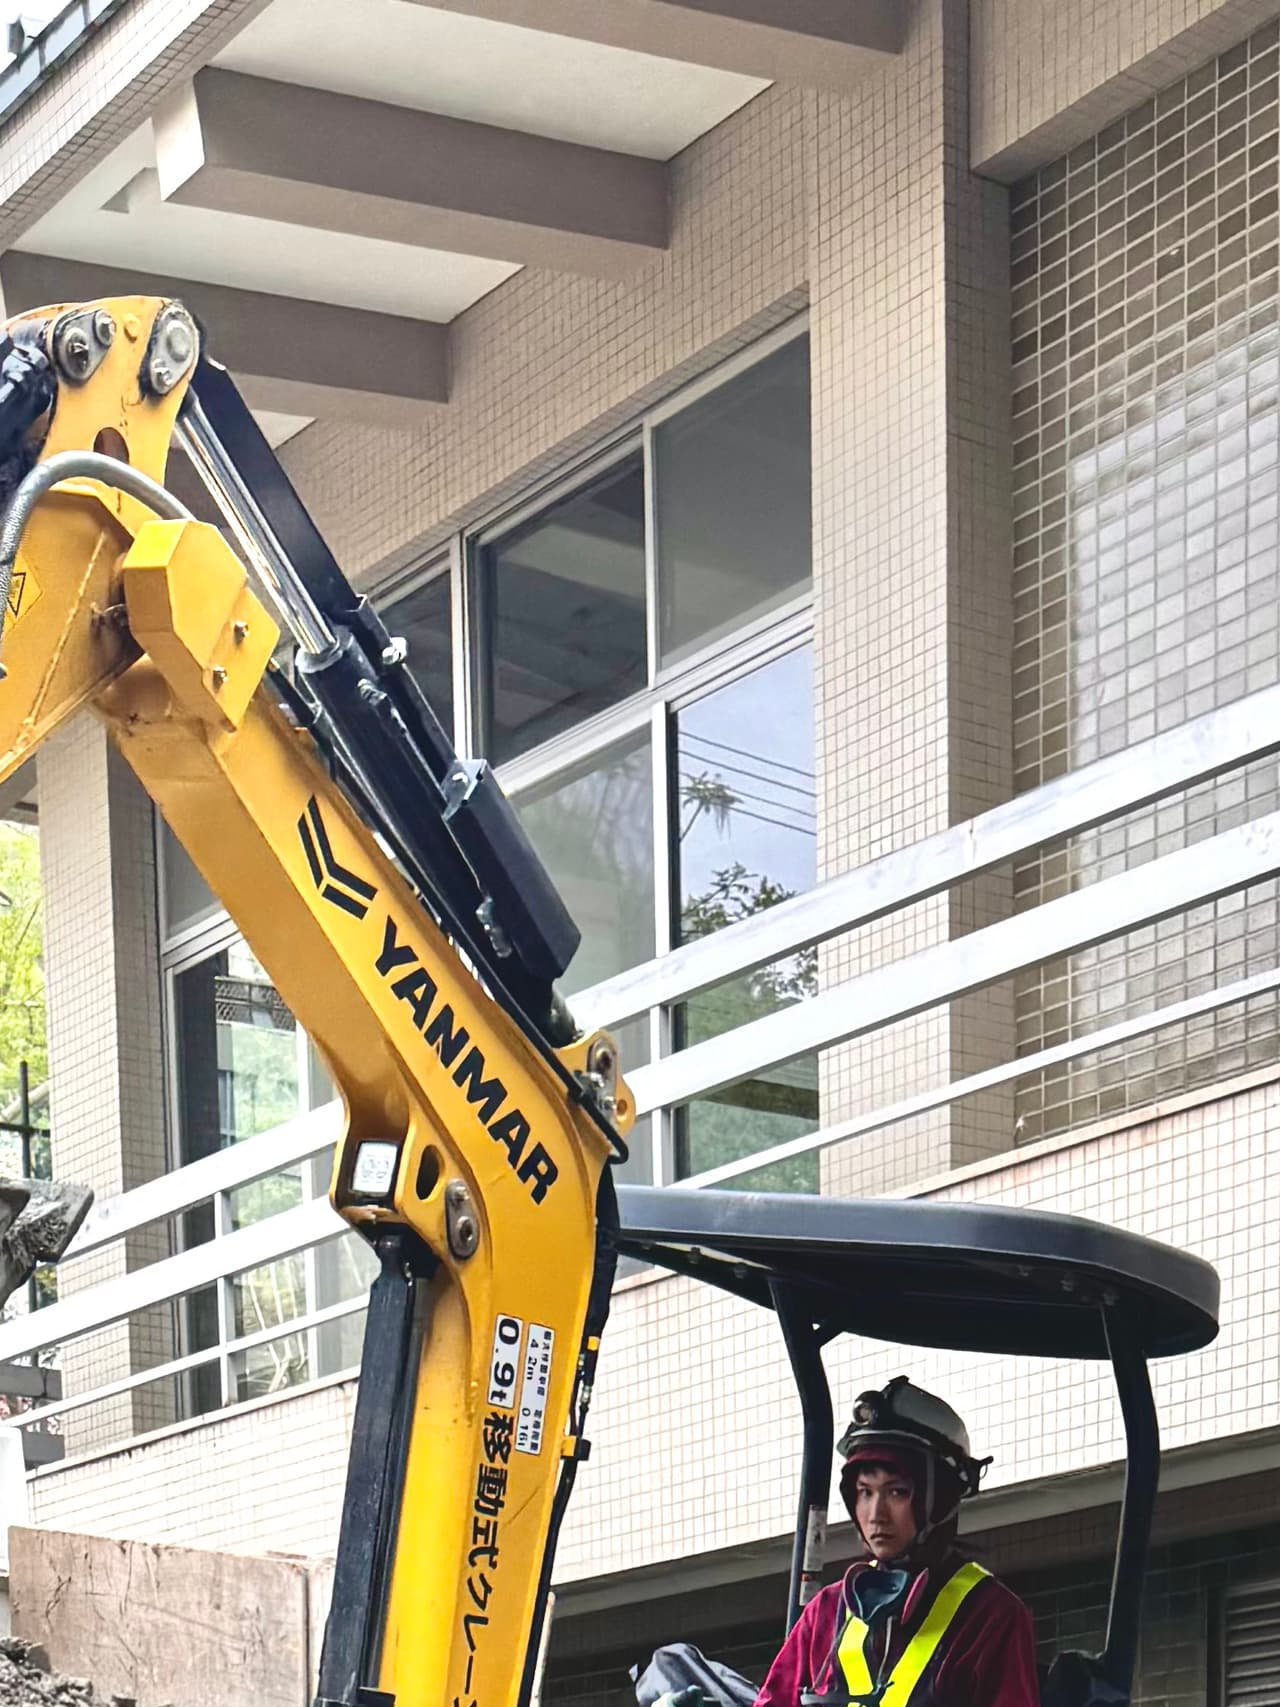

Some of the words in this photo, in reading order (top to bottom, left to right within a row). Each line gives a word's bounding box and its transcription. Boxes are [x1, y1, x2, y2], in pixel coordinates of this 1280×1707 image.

[375, 915, 559, 1205] YANMAR
[490, 1317, 520, 1402] 0.9t
[526, 1338, 539, 1380] 42m
